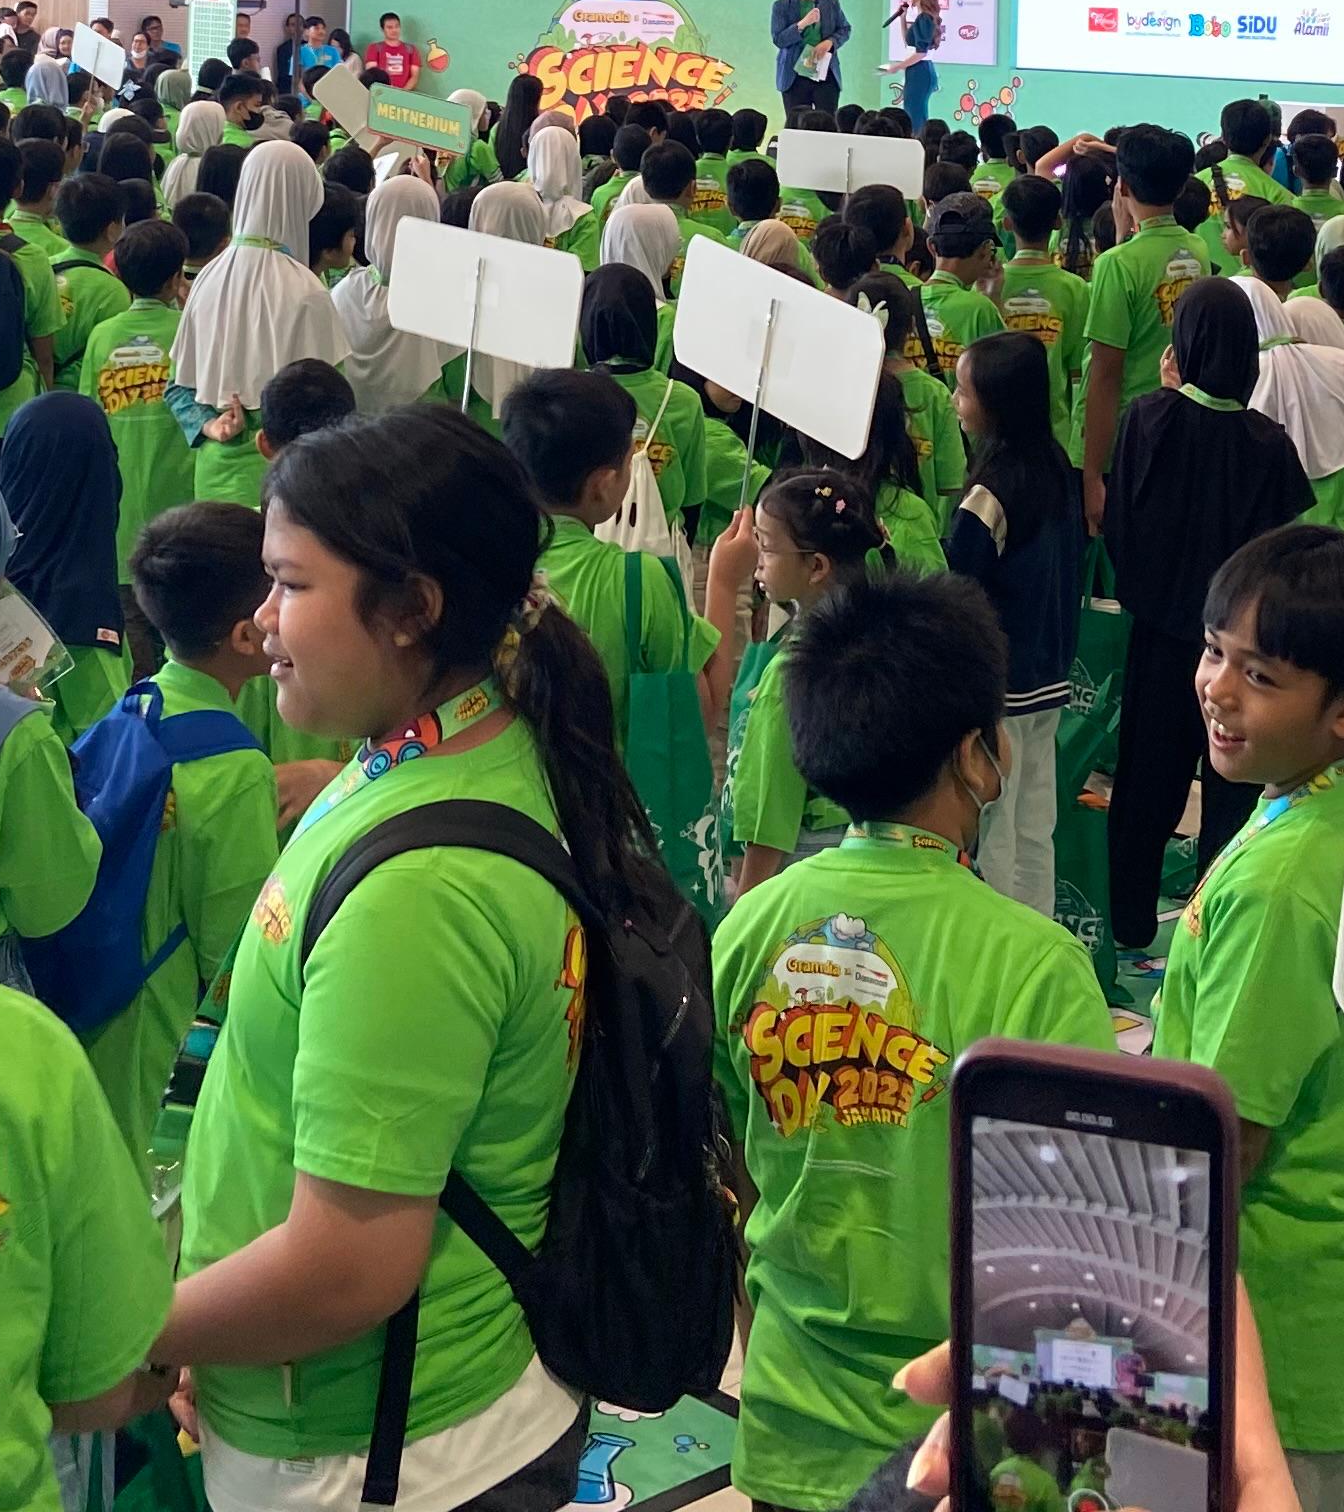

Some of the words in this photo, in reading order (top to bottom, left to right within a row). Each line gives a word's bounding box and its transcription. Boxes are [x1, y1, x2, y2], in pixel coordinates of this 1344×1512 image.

[572, 9, 632, 24] Gramedia
[1126, 12, 1182, 31] bydesign
[1188, 13, 1231, 38] Bobo
[1237, 14, 1277, 34] SiDU
[530, 45, 735, 110] SCIENCE
[376, 102, 462, 137] MEITNERIUM
[834, 1067, 914, 1115] 2025
